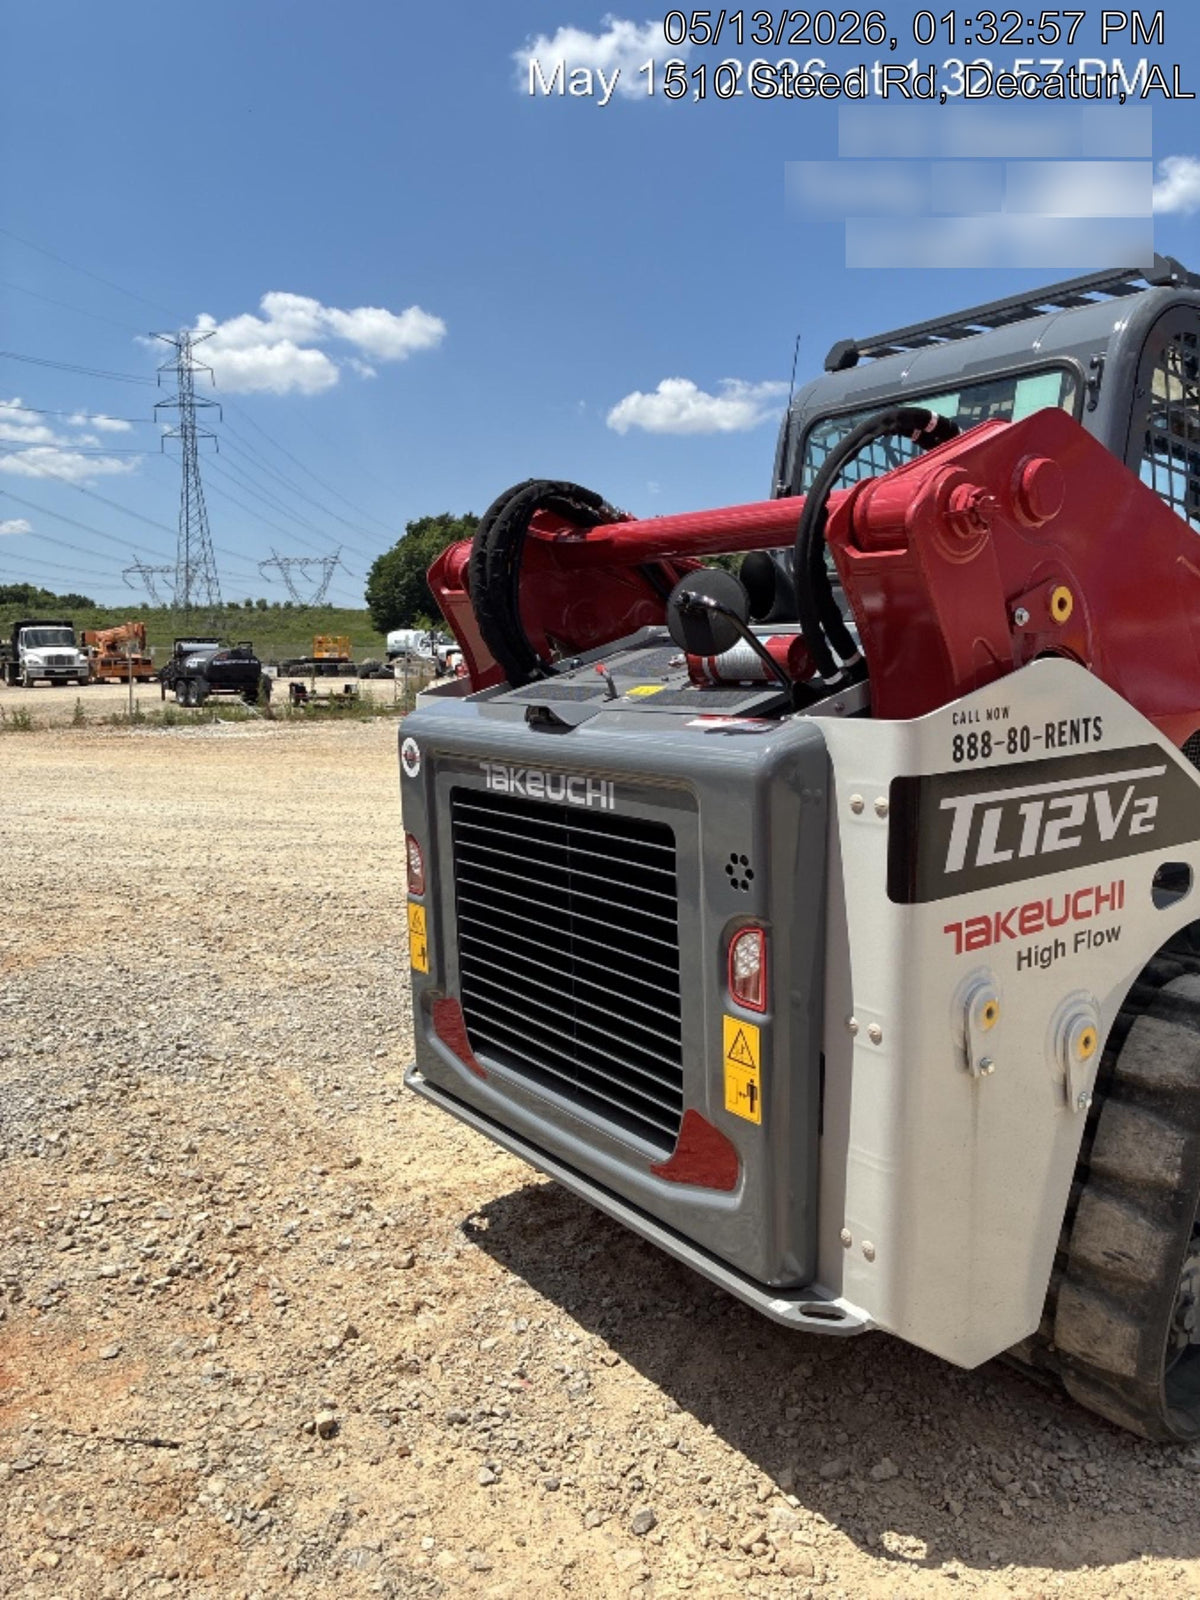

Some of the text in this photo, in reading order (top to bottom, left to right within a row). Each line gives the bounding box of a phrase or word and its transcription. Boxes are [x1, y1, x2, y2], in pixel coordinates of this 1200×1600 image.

[952, 705, 1011, 725] CALL NOW
[952, 716, 1104, 763] 888-80-RENTS
[480, 762, 615, 810] TAKEUCHI
[943, 880, 1125, 955] TAKEUCHI
[1016, 925, 1122, 971] High Flow
